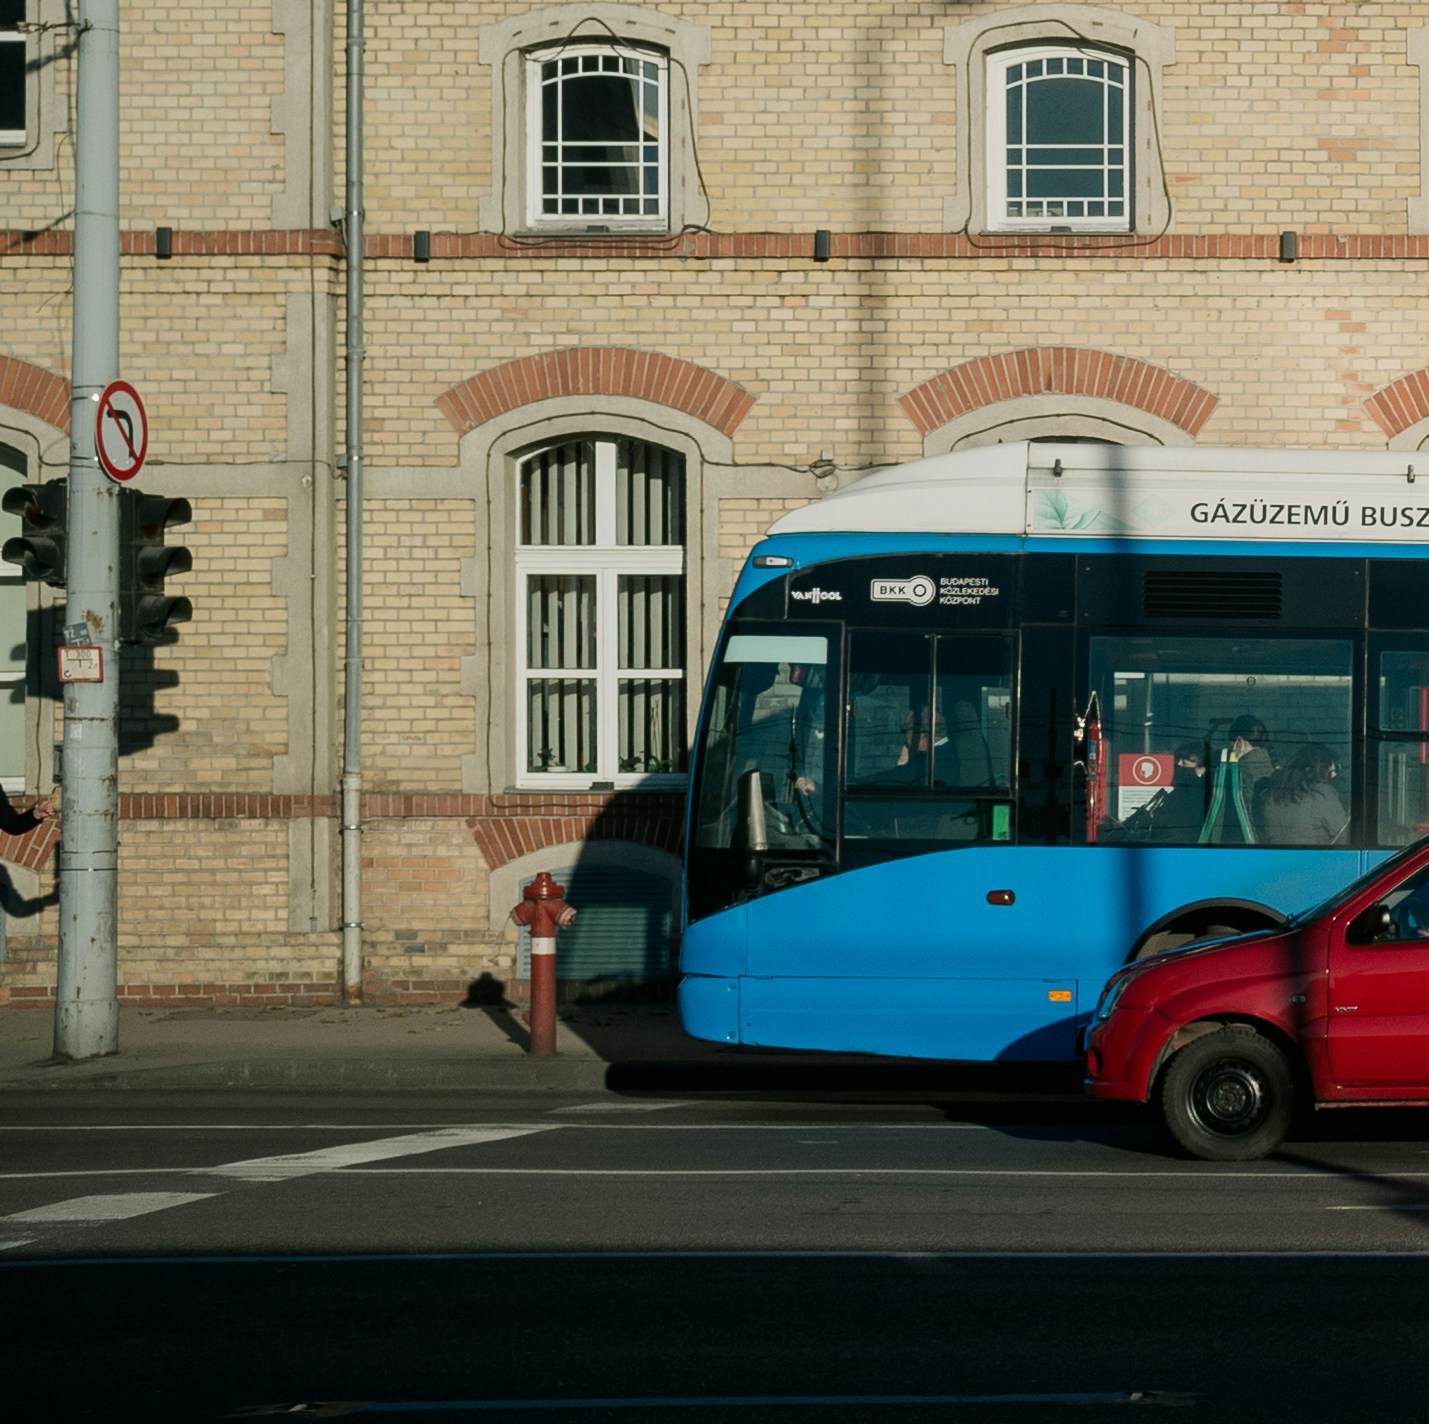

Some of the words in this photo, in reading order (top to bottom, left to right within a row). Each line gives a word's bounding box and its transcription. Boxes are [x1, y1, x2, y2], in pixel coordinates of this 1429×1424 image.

[1189, 497, 1350, 527] GÁZÜZEMŰ
[940, 577, 989, 586] BUDAPESTI
[879, 585, 906, 595] BKK
